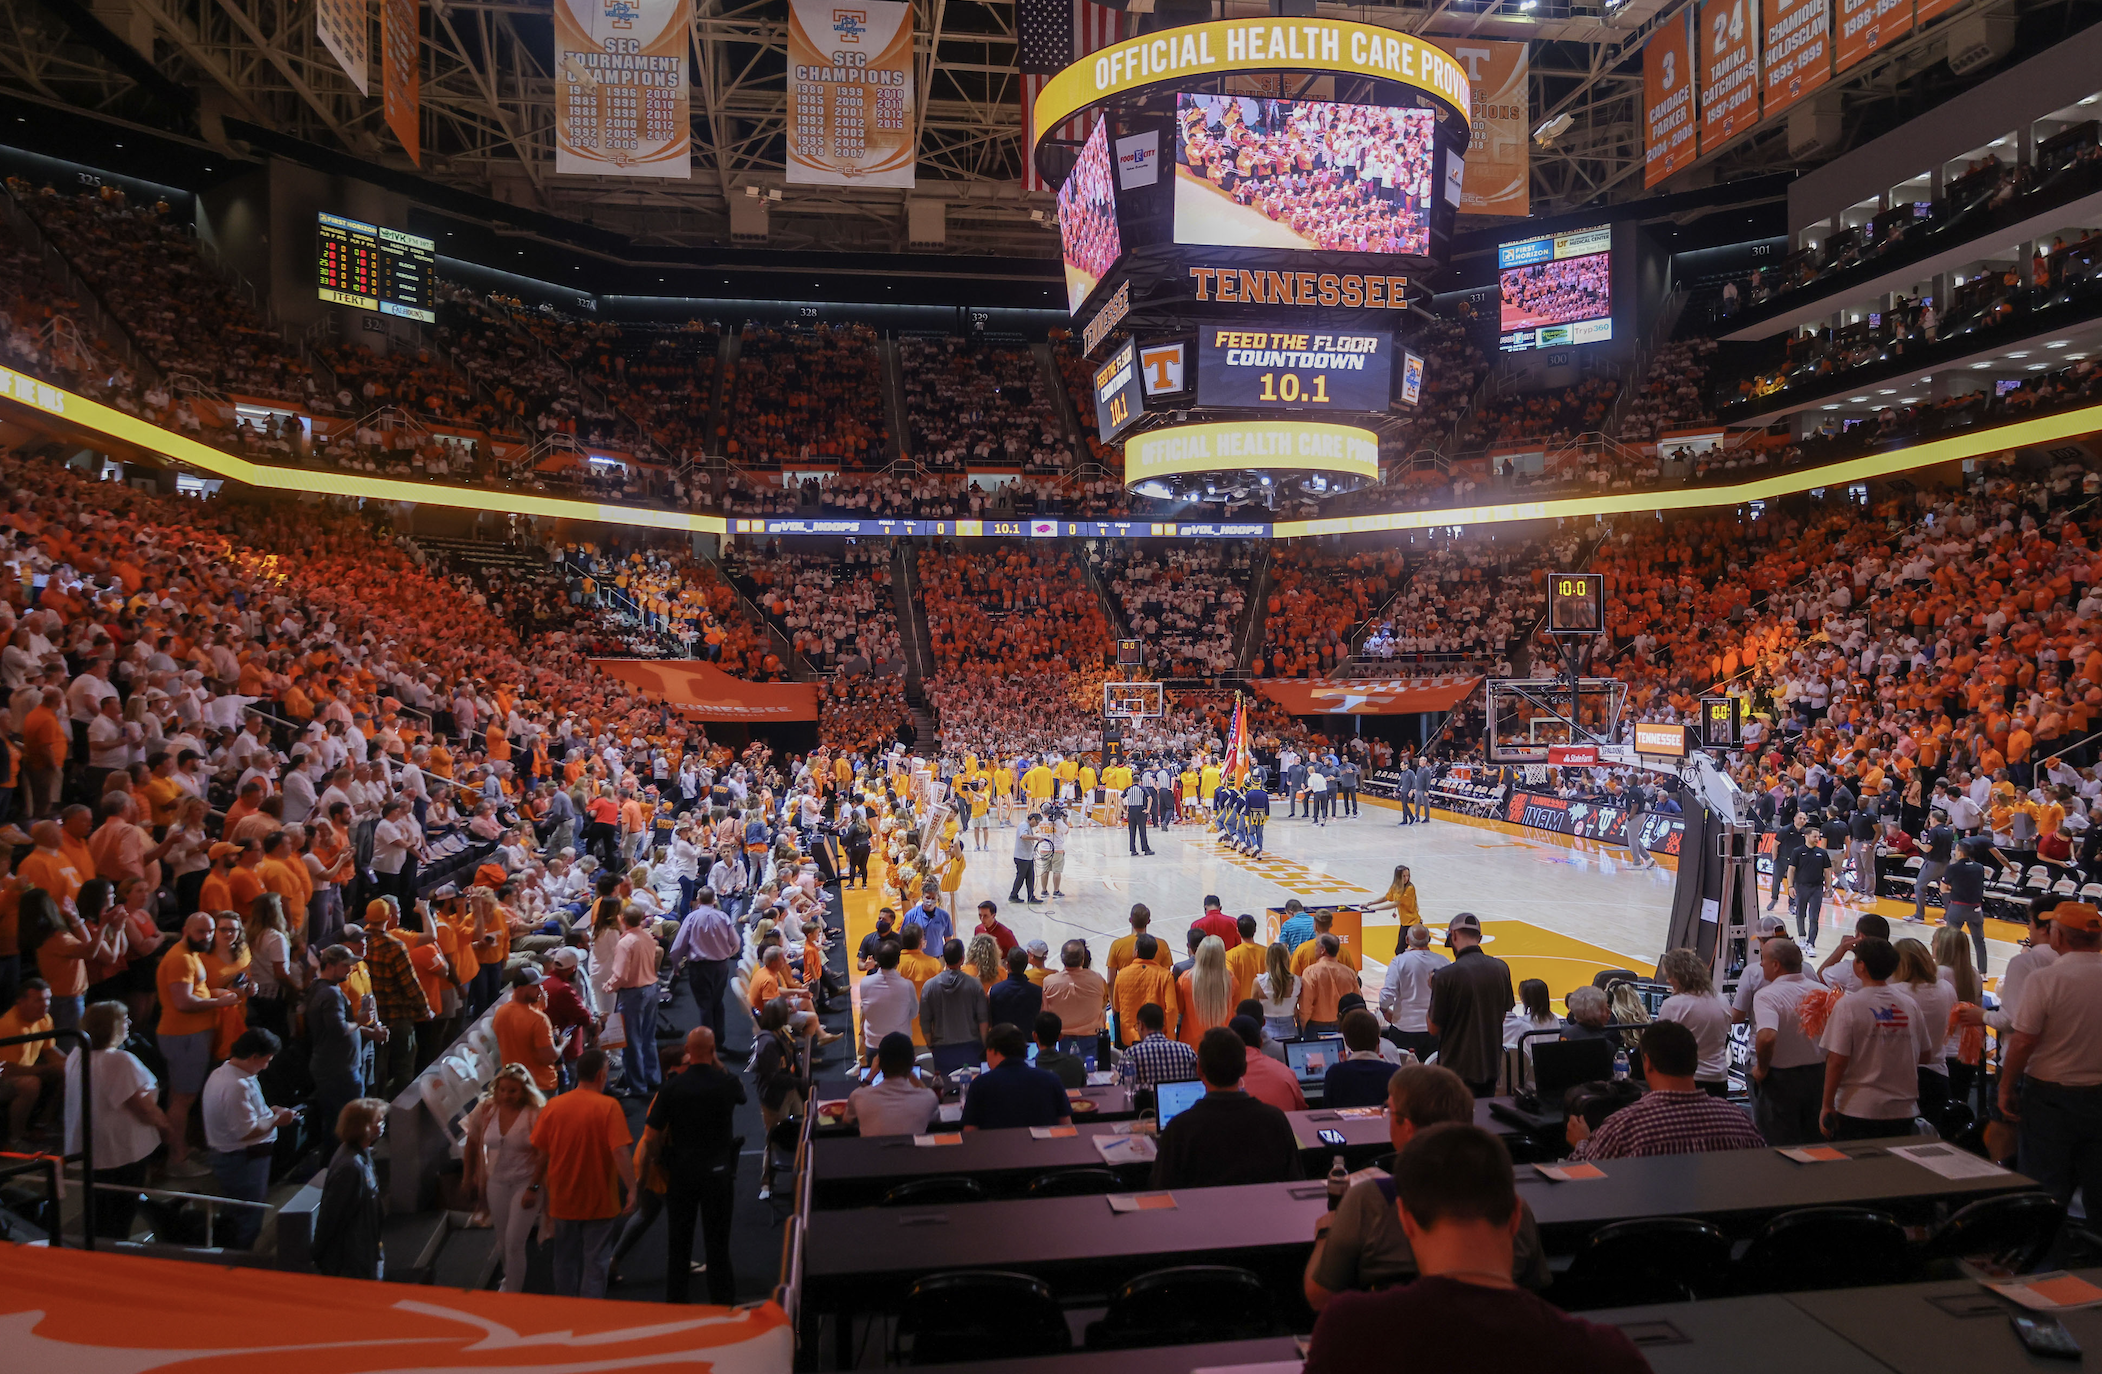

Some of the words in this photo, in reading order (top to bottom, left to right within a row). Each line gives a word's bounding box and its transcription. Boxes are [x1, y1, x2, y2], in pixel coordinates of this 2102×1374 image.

[1713, 0, 1745, 57] 24
[1768, 0, 1824, 45] CHAMIQUE
[604, 37, 639, 54] SEC
[1765, 10, 1828, 69] HOLDSCLAW
[832, 50, 866, 67] SEC
[1095, 31, 1215, 90] OFFICIAL
[1227, 26, 1339, 62] HEALTH
[1351, 31, 1414, 77] CARE
[1710, 45, 1747, 83] TAMIKA
[1768, 39, 1823, 88] 1995-1999
[796, 65, 904, 85] CHAMPIONS
[1662, 50, 1675, 91] 3
[1702, 57, 1757, 107] CATCHINGS
[606, 87, 637, 97] 1996
[646, 89, 676, 99] 2008
[797, 84, 824, 94] 1980
[836, 87, 864, 97] 1999
[876, 89, 904, 99] 2010
[1470, 89, 1488, 103] EC
[569, 96, 597, 106] 1985
[606, 98, 637, 108] 1998
[646, 100, 674, 110] 2010
[797, 95, 824, 105] 1985
[835, 97, 864, 107] 2000
[877, 99, 903, 109] 2011
[1649, 83, 1690, 124] CANDACE
[1706, 83, 1752, 126] 1997-2001
[569, 106, 597, 116] 1988
[606, 108, 637, 118] 1999
[646, 110, 673, 120] 2011
[797, 105, 824, 115] 1990
[834, 107, 864, 117] 2001
[877, 110, 903, 120] 2013
[569, 117, 597, 127] 1989
[605, 119, 637, 129] 2000
[646, 121, 674, 130] 2012
[797, 115, 824, 125] 1993
[834, 118, 865, 128] 2002
[877, 120, 903, 129] 2015
[1652, 105, 1687, 141] PARKER
[569, 127, 598, 137] 1992
[605, 129, 637, 139] 2005
[646, 131, 674, 141] 2014
[797, 125, 825, 135] 1994
[834, 128, 865, 138] 2003
[569, 138, 598, 148] 1994
[605, 140, 638, 150] 2006
[797, 136, 824, 146] 1995
[834, 138, 865, 148] 2004
[1468, 141, 1484, 150] 018
[797, 146, 825, 156] 1998
[834, 148, 865, 158] 2007
[1120, 154, 1134, 163] FOOD
[1143, 149, 1156, 158] CITY
[607, 156, 636, 164] SEC
[77, 172, 101, 187] 325
[328, 216, 346, 226] FIRST
[347, 222, 377, 234] HORIZON
[1569, 238, 1591, 246] MEDICAL
[1591, 235, 1609, 243] CENTER
[1515, 245, 1536, 254] FIRST
[1752, 245, 1770, 257] 301
[1189, 267, 1408, 309] TENNESSEE
[333, 291, 365, 306] JTEKT
[577, 297, 596, 311] 327A
[1470, 293, 1486, 303] 331
[800, 307, 818, 317] 328
[1082, 278, 1130, 359] TENNESSEE
[1575, 323, 1610, 336] Tryp360
[1215, 331, 1268, 349] FEED
[1270, 333, 1310, 351] THE
[1312, 335, 1378, 354] FLOOR
[1226, 350, 1365, 370] COUNTDOWN
[1548, 354, 1567, 365] 300
[1096, 369, 1108, 391] FEED
[1108, 359, 1117, 380] THE
[1259, 372, 1330, 403] 10.1
[1109, 392, 1129, 428] 10.1
[1142, 435, 1211, 466] OFFICIAL
[1216, 432, 1292, 458] HEALTH
[1298, 433, 1343, 459] CARE
[769, 521, 860, 533] @VOL_HOOPS
[937, 524, 945, 535] 0
[994, 524, 1020, 534] 10.1
[1069, 524, 1076, 535] 0
[1180, 525, 1264, 536] @VOL_HOOPS
[1559, 580, 1586, 596] 10.0
[1636, 732, 1682, 746] TENNESSEE
[1601, 746, 1624, 756] SPALDING
